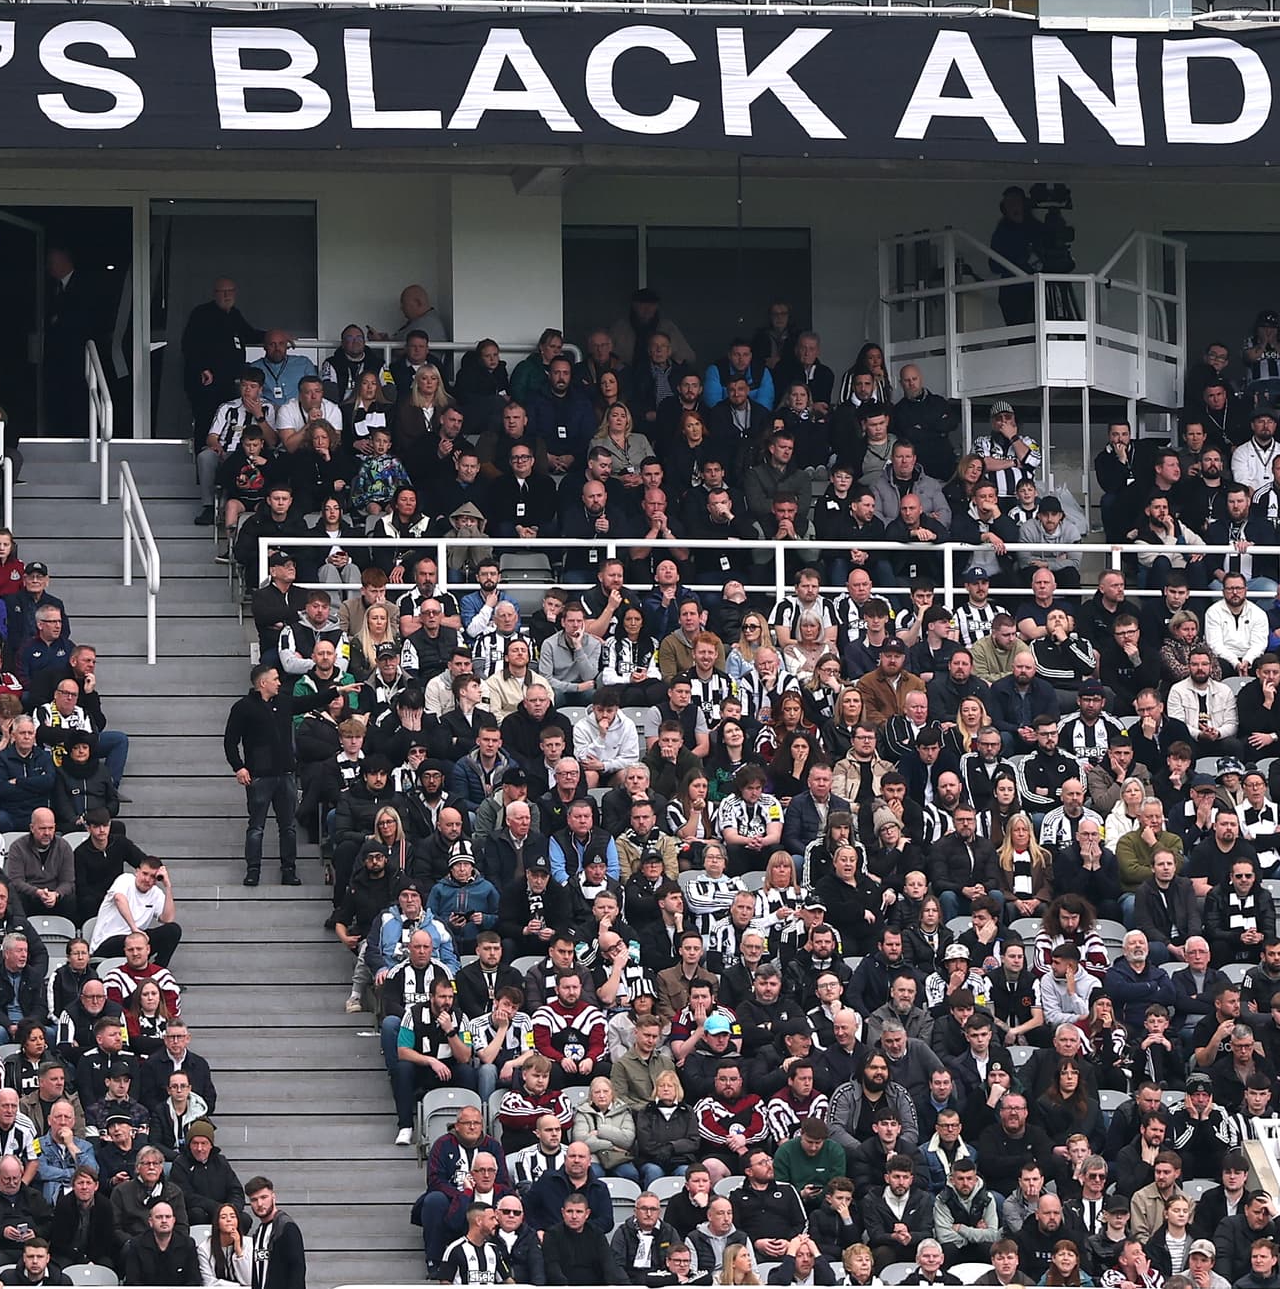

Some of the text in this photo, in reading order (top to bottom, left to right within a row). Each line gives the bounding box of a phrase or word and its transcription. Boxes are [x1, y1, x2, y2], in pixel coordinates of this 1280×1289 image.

[211, 26, 847, 139] BLACK
[895, 30, 1271, 146] AND
[476, 1271, 495, 1283] sela
